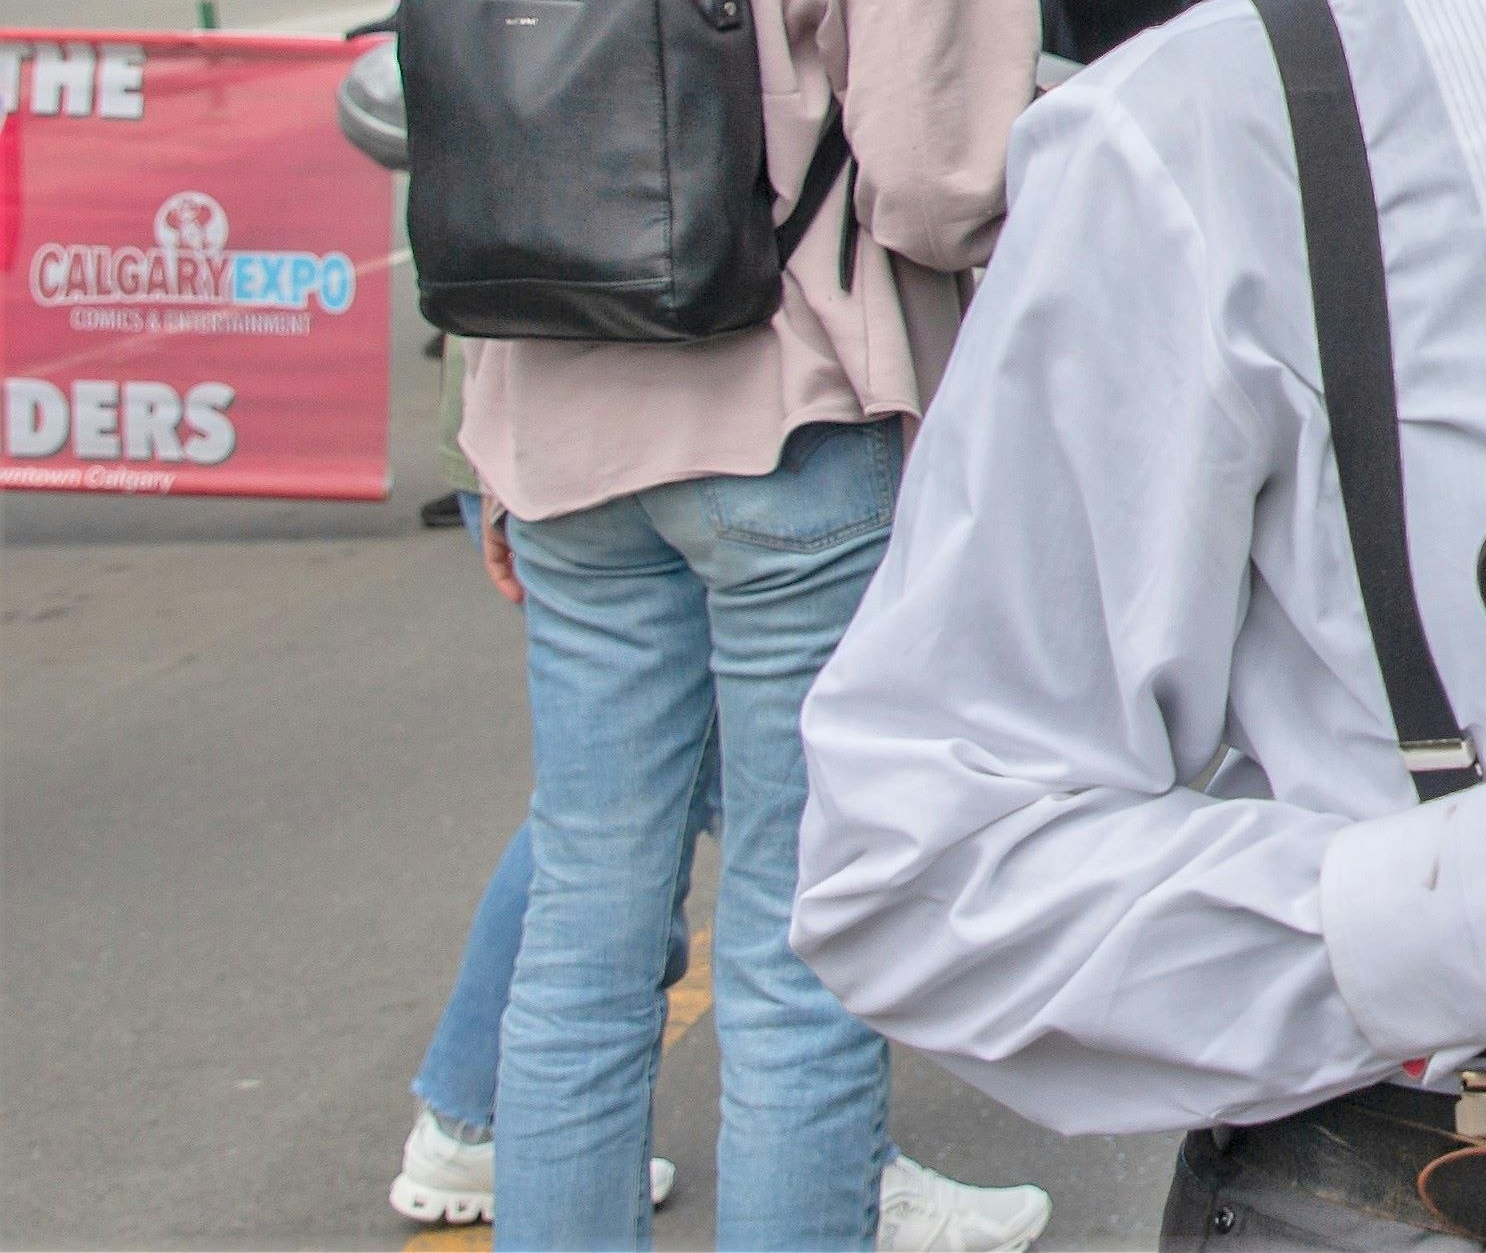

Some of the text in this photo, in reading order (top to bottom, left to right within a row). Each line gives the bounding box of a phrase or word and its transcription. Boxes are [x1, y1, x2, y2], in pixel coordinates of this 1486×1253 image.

[0, 43, 146, 120] THE
[4, 378, 236, 466] DERS
[83, 464, 176, 495] Calgary
